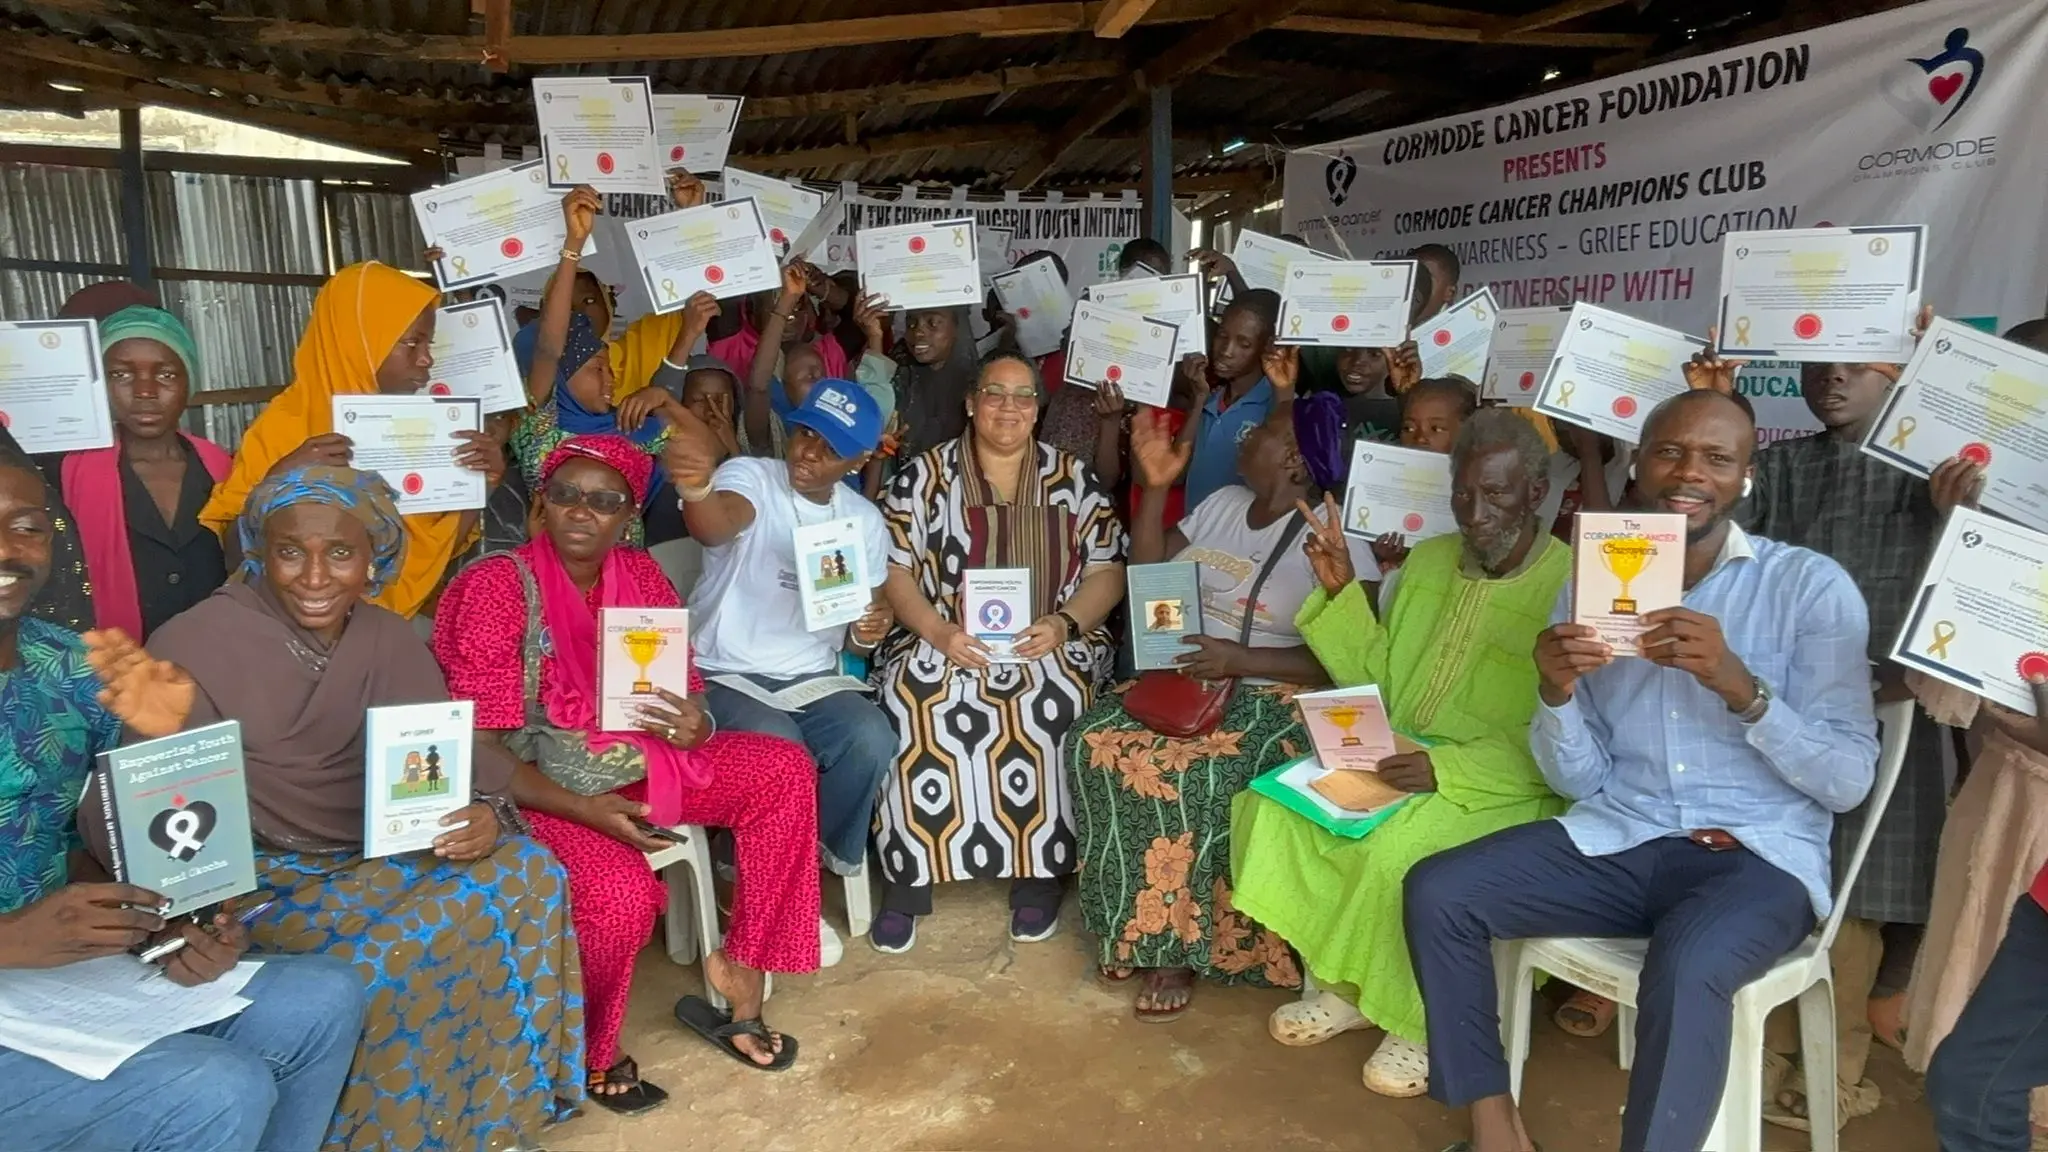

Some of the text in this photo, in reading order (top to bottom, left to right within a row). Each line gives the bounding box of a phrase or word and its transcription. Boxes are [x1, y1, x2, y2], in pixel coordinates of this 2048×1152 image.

[1383, 44, 1810, 166] CORMODE CANCER FOUNDATION
[1503, 142, 1607, 183] PRESENTS
[1858, 136, 1997, 170] CORMODE
[1394, 161, 1767, 235] CORMODE CANCER CHAMPIONS CLUB
[1035, 208, 1081, 240] YOUTH
[1448, 232, 1548, 266] WARENESS
[1578, 222, 1642, 256] GRIEF
[1649, 205, 1798, 249] EDUCATION
[1463, 273, 1616, 308] PRTNERSHIP
[1623, 267, 1695, 302] WITH
[1623, 519, 1641, 531] The
[119, 735, 236, 769] Empowering Youth
[129, 762, 183, 784] Against
[183, 752, 230, 769] Cancer
